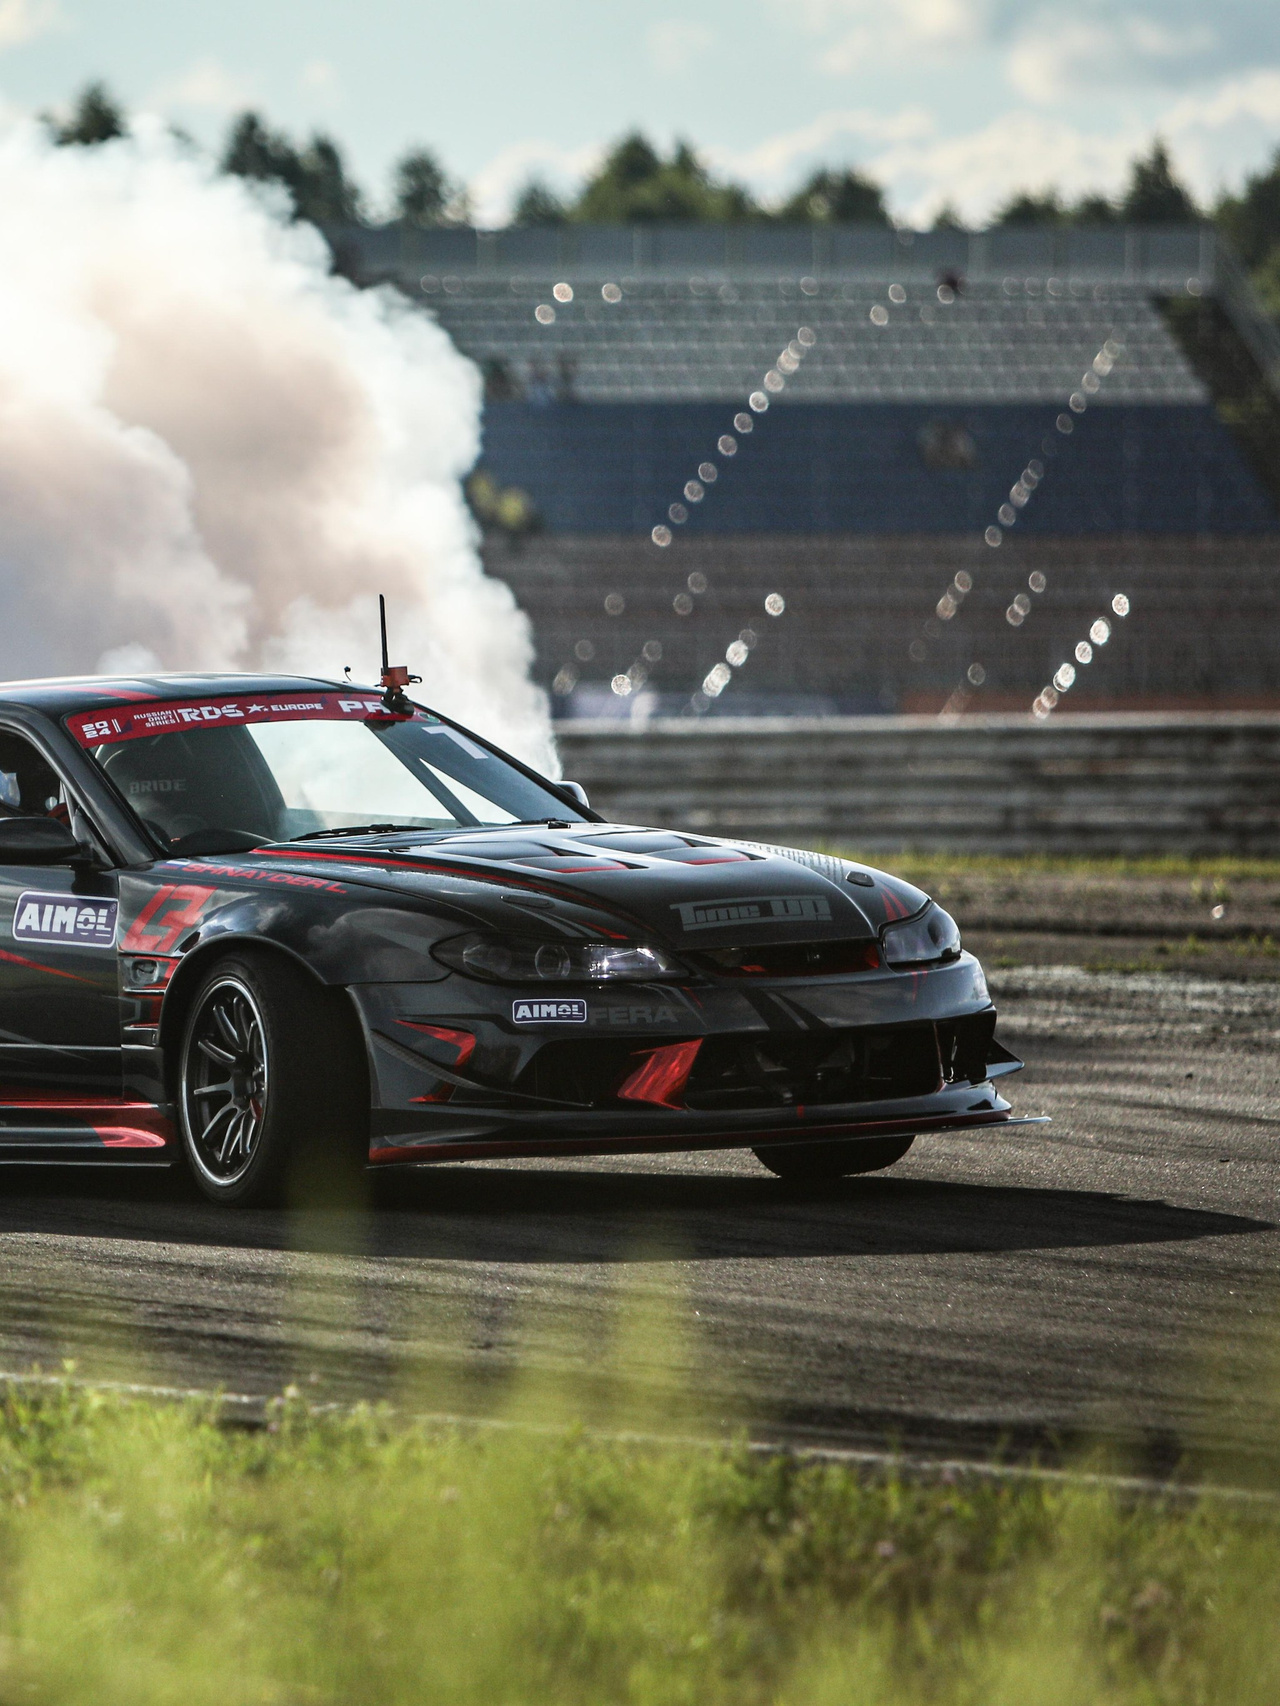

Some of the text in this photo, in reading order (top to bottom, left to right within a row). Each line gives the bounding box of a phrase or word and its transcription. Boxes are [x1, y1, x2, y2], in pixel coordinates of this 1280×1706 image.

[271, 703, 324, 712] EUROPE
[134, 710, 172, 720] RUSSIAN
[148, 715, 173, 723] DRIFT
[82, 720, 109, 731] 20
[145, 719, 176, 728] SERIES
[85, 729, 111, 739] 24
[129, 779, 187, 793] BRIDE
[181, 862, 325, 889] SHNAYDER
[17, 903, 112, 937] AIMOL
[516, 1004, 583, 1018] AIMOL
[588, 1005, 678, 1026] FERA
